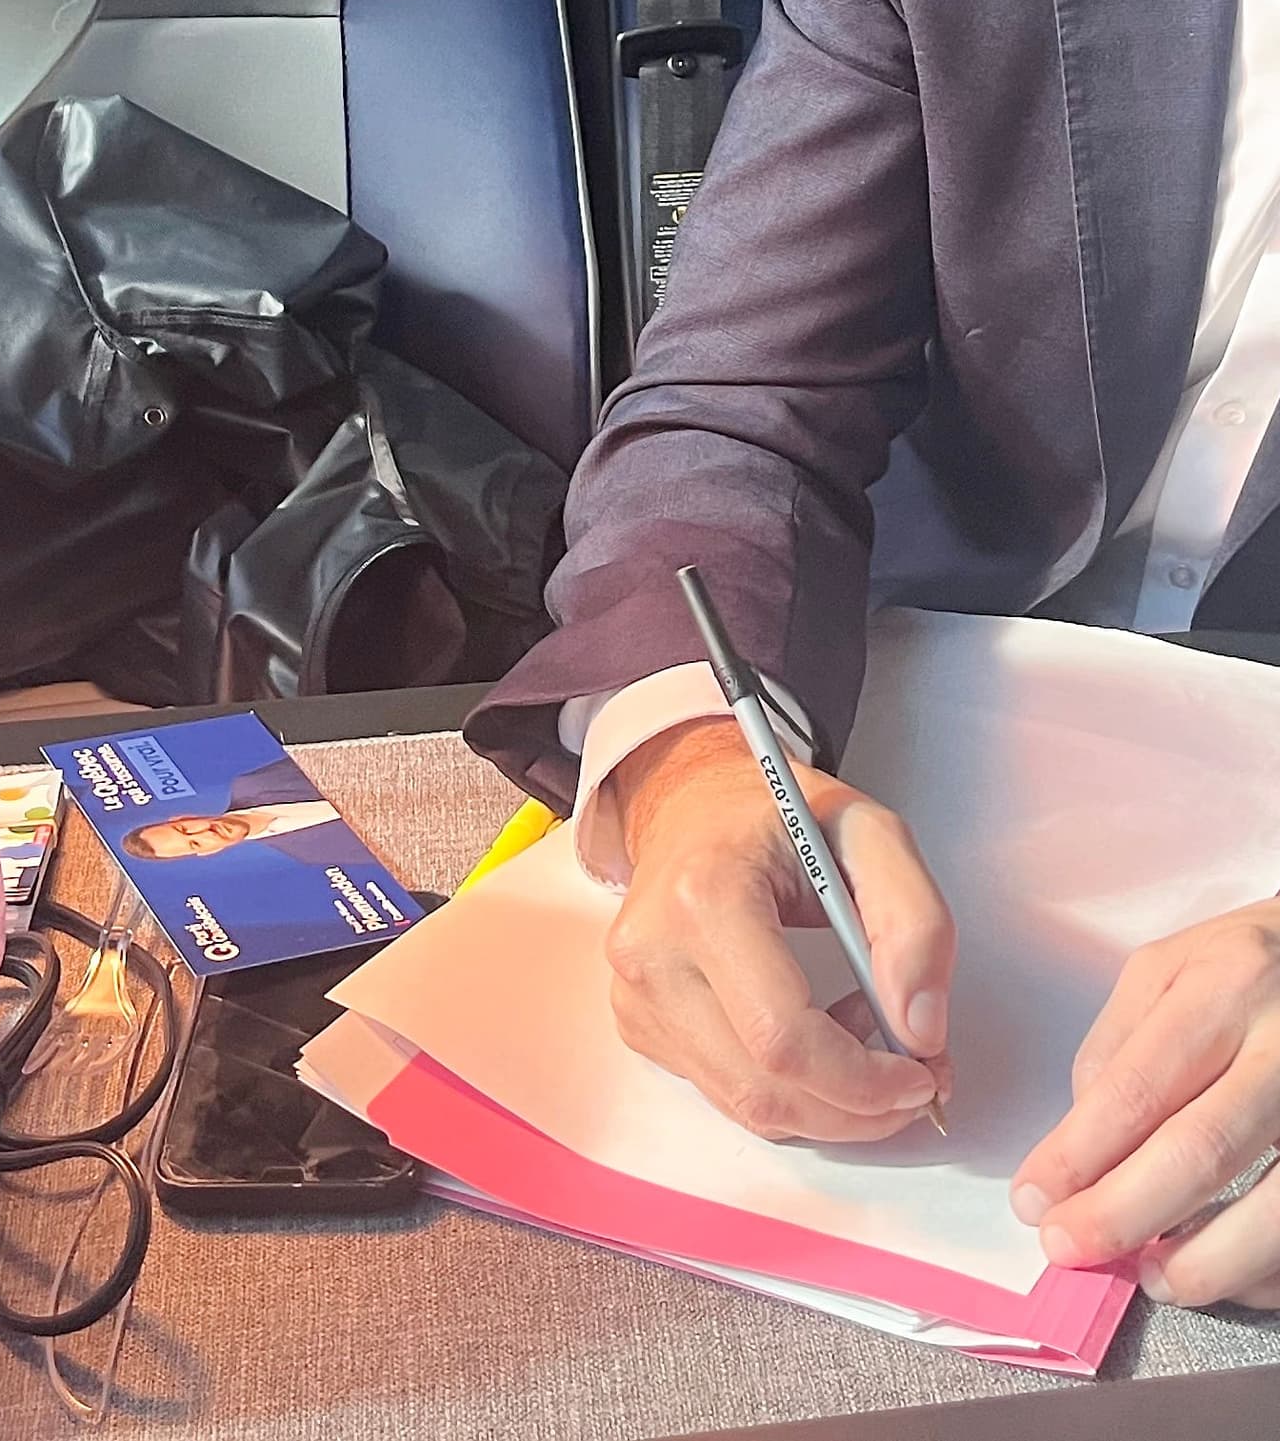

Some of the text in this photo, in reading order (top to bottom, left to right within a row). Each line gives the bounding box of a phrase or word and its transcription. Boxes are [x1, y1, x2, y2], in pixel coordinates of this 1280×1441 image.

[73, 748, 124, 811] Le Québec
[122, 786, 153, 806] qui
[152, 767, 187, 795] Pour
[760, 754, 830, 895] 1.800.567.0223
[325, 866, 389, 932] Plamondon
